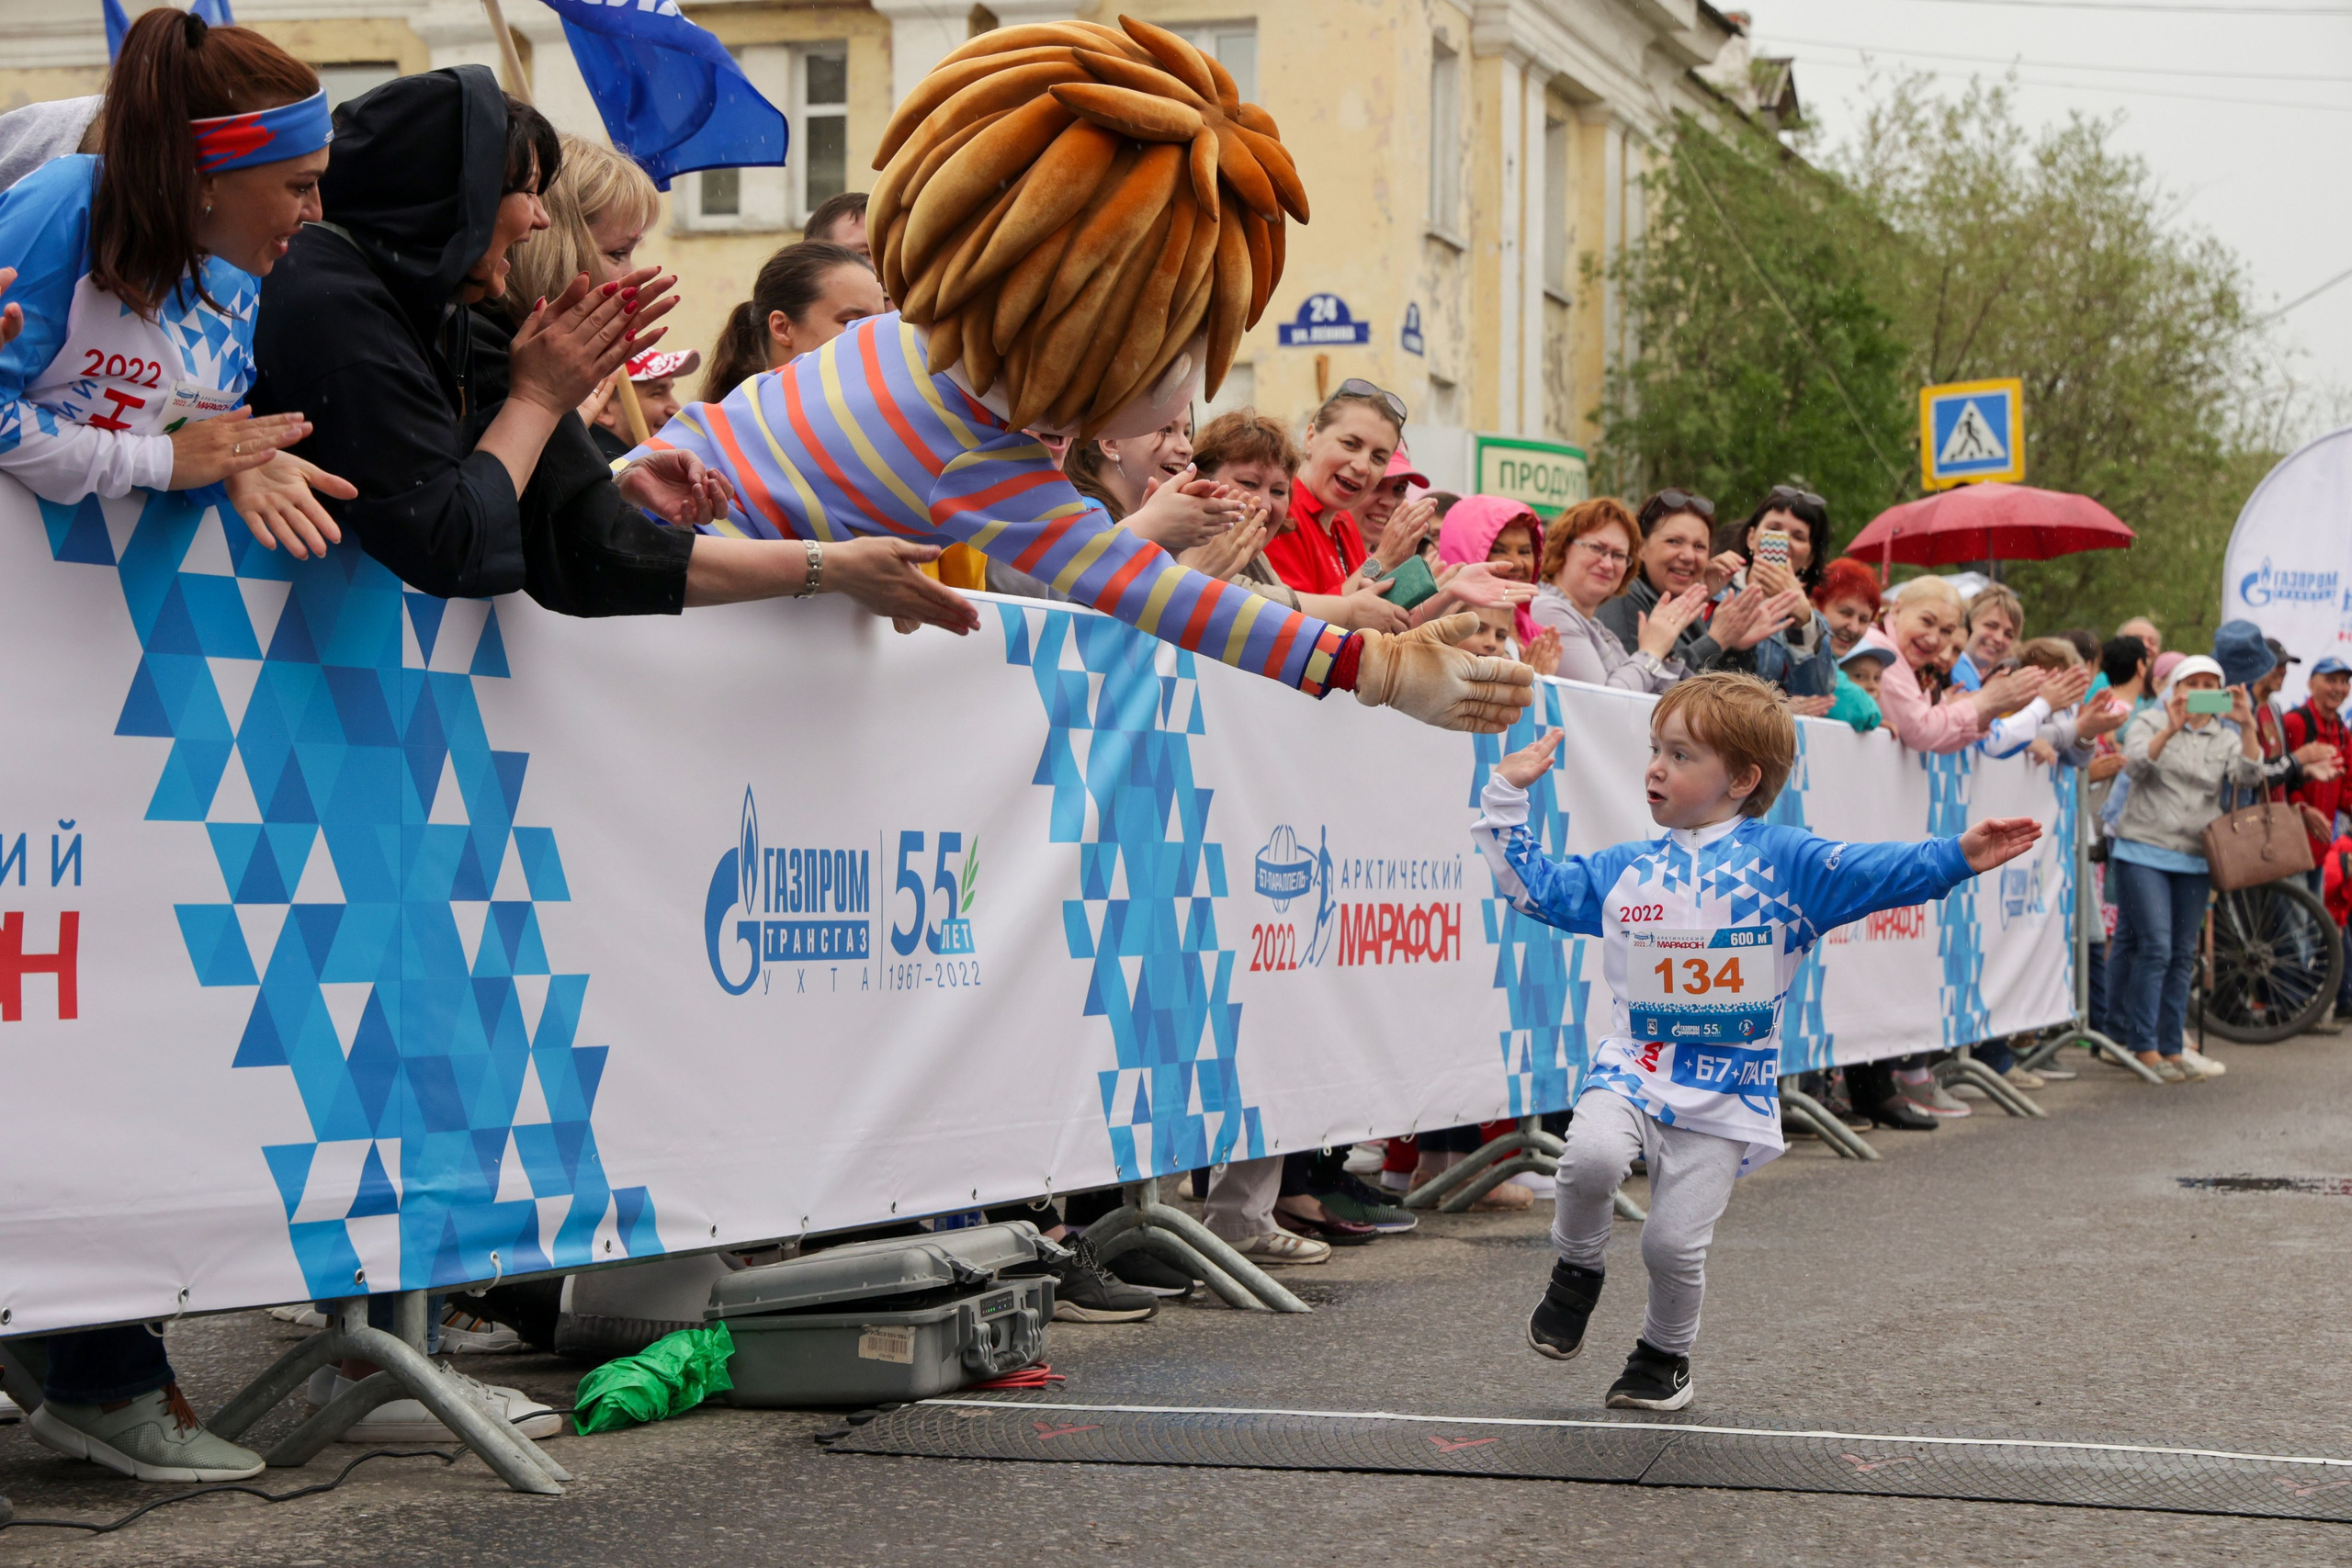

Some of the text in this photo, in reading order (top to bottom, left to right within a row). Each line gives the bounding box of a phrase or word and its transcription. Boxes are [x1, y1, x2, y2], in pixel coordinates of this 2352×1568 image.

[1309, 297, 1338, 321] 24
[80, 349, 161, 389] 2022
[763, 847, 870, 913] ГАЗПРОМ
[1340, 853, 1463, 890] АРКТИЧЕСКИЙ
[890, 830, 962, 956] 55
[1620, 904, 1664, 923] 2022
[766, 926, 868, 953] ТРАНСГАЗ
[941, 923, 970, 950] ЛЕТ
[1250, 923, 1297, 972] 2022
[1338, 901, 1461, 966] МАРАФОН
[1634, 940, 1646, 948] 2022
[1657, 941, 1704, 950] МАРАФОН
[1730, 931, 1752, 947] 600
[1655, 957, 1745, 995] 134
[1702, 1023, 1719, 1035] 55
[1695, 1054, 1733, 1083] 67
[1737, 1059, 1778, 1087] ПАР
